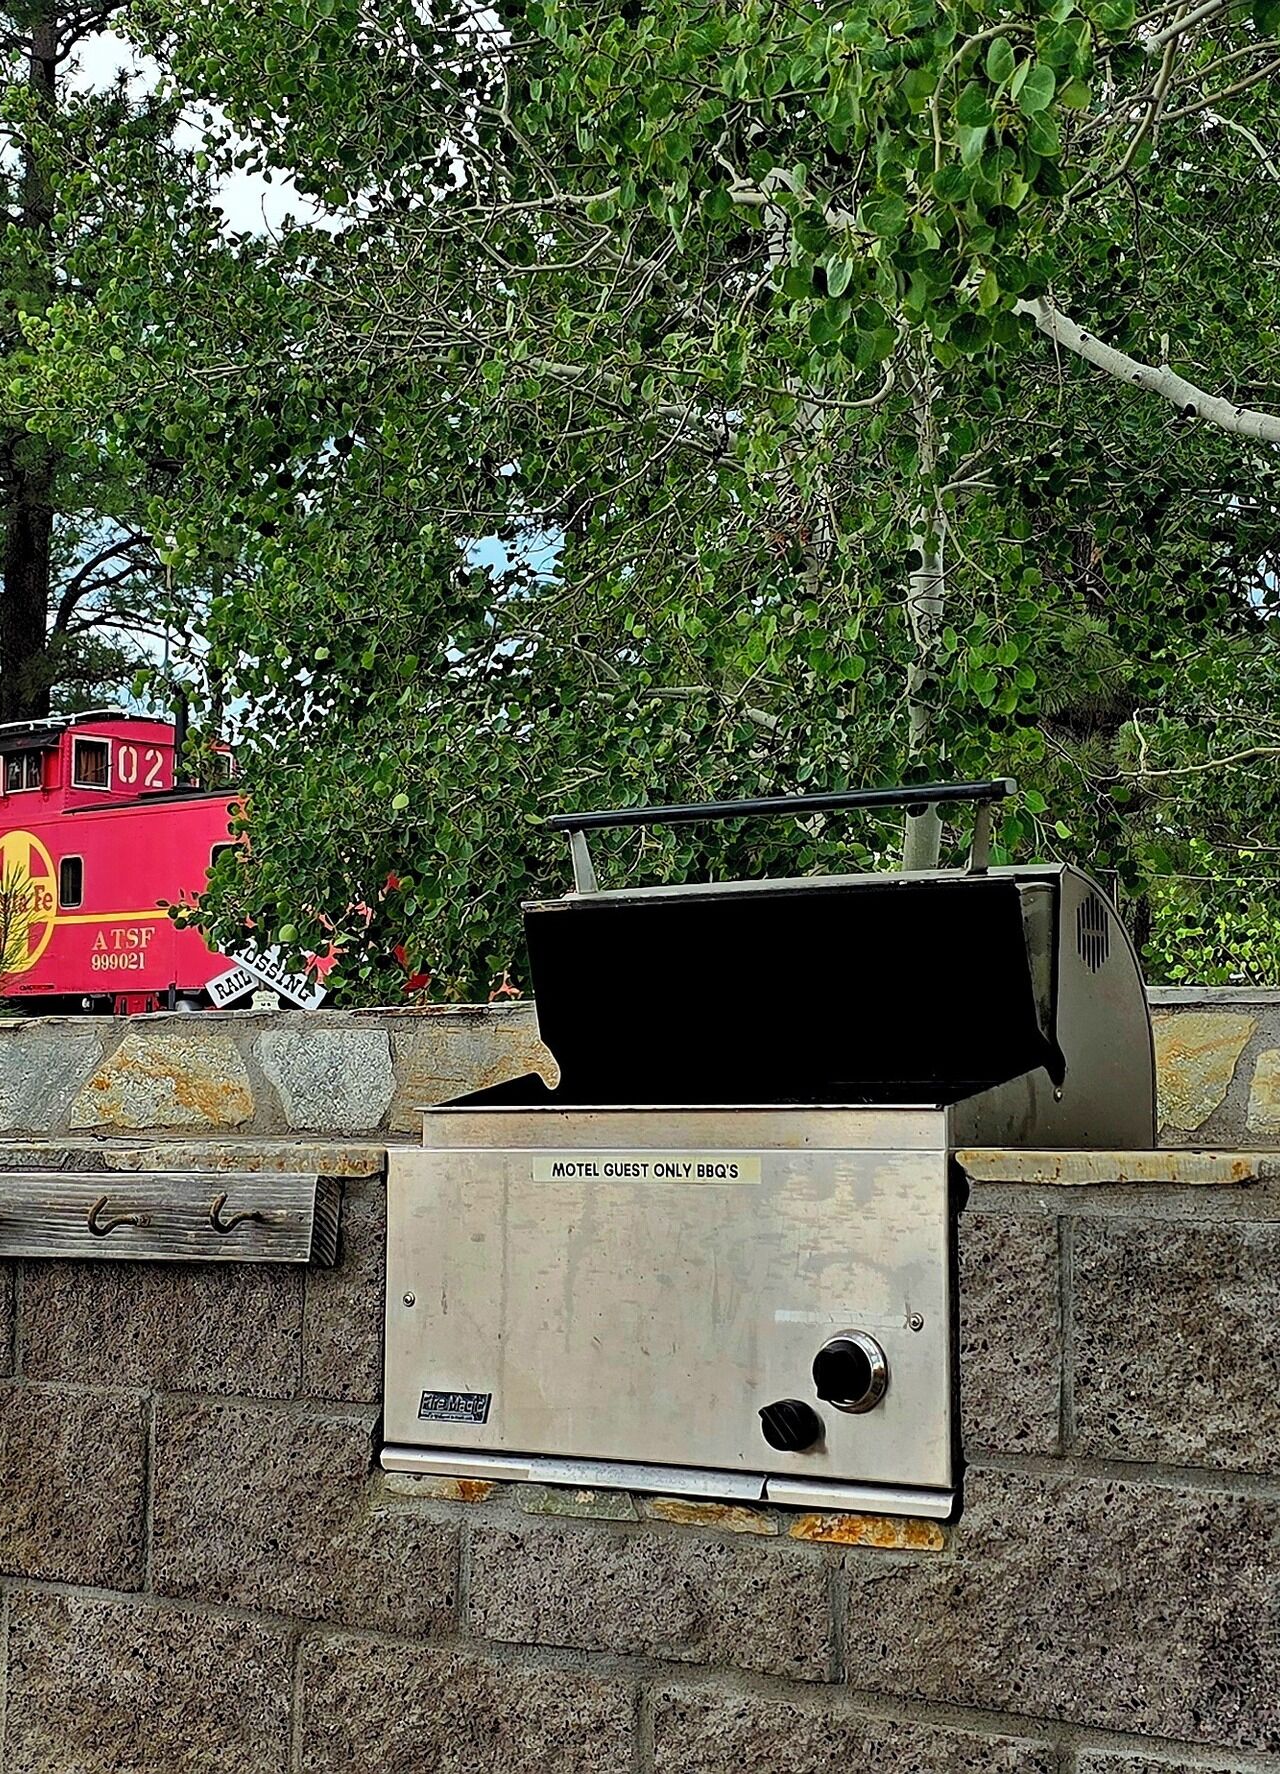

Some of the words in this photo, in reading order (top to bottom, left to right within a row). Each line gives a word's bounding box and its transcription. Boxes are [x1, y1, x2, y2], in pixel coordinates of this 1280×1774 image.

[118, 745, 163, 787] 02
[34, 885, 53, 913] Fe
[92, 927, 155, 951] ATSF
[91, 952, 145, 971] 999021
[214, 970, 253, 1000] RAIL
[552, 1163, 599, 1177] MOTEL
[604, 1163, 649, 1177] GUEST
[654, 1163, 692, 1178] ONLY
[697, 1164, 739, 1179] BBQ'S
